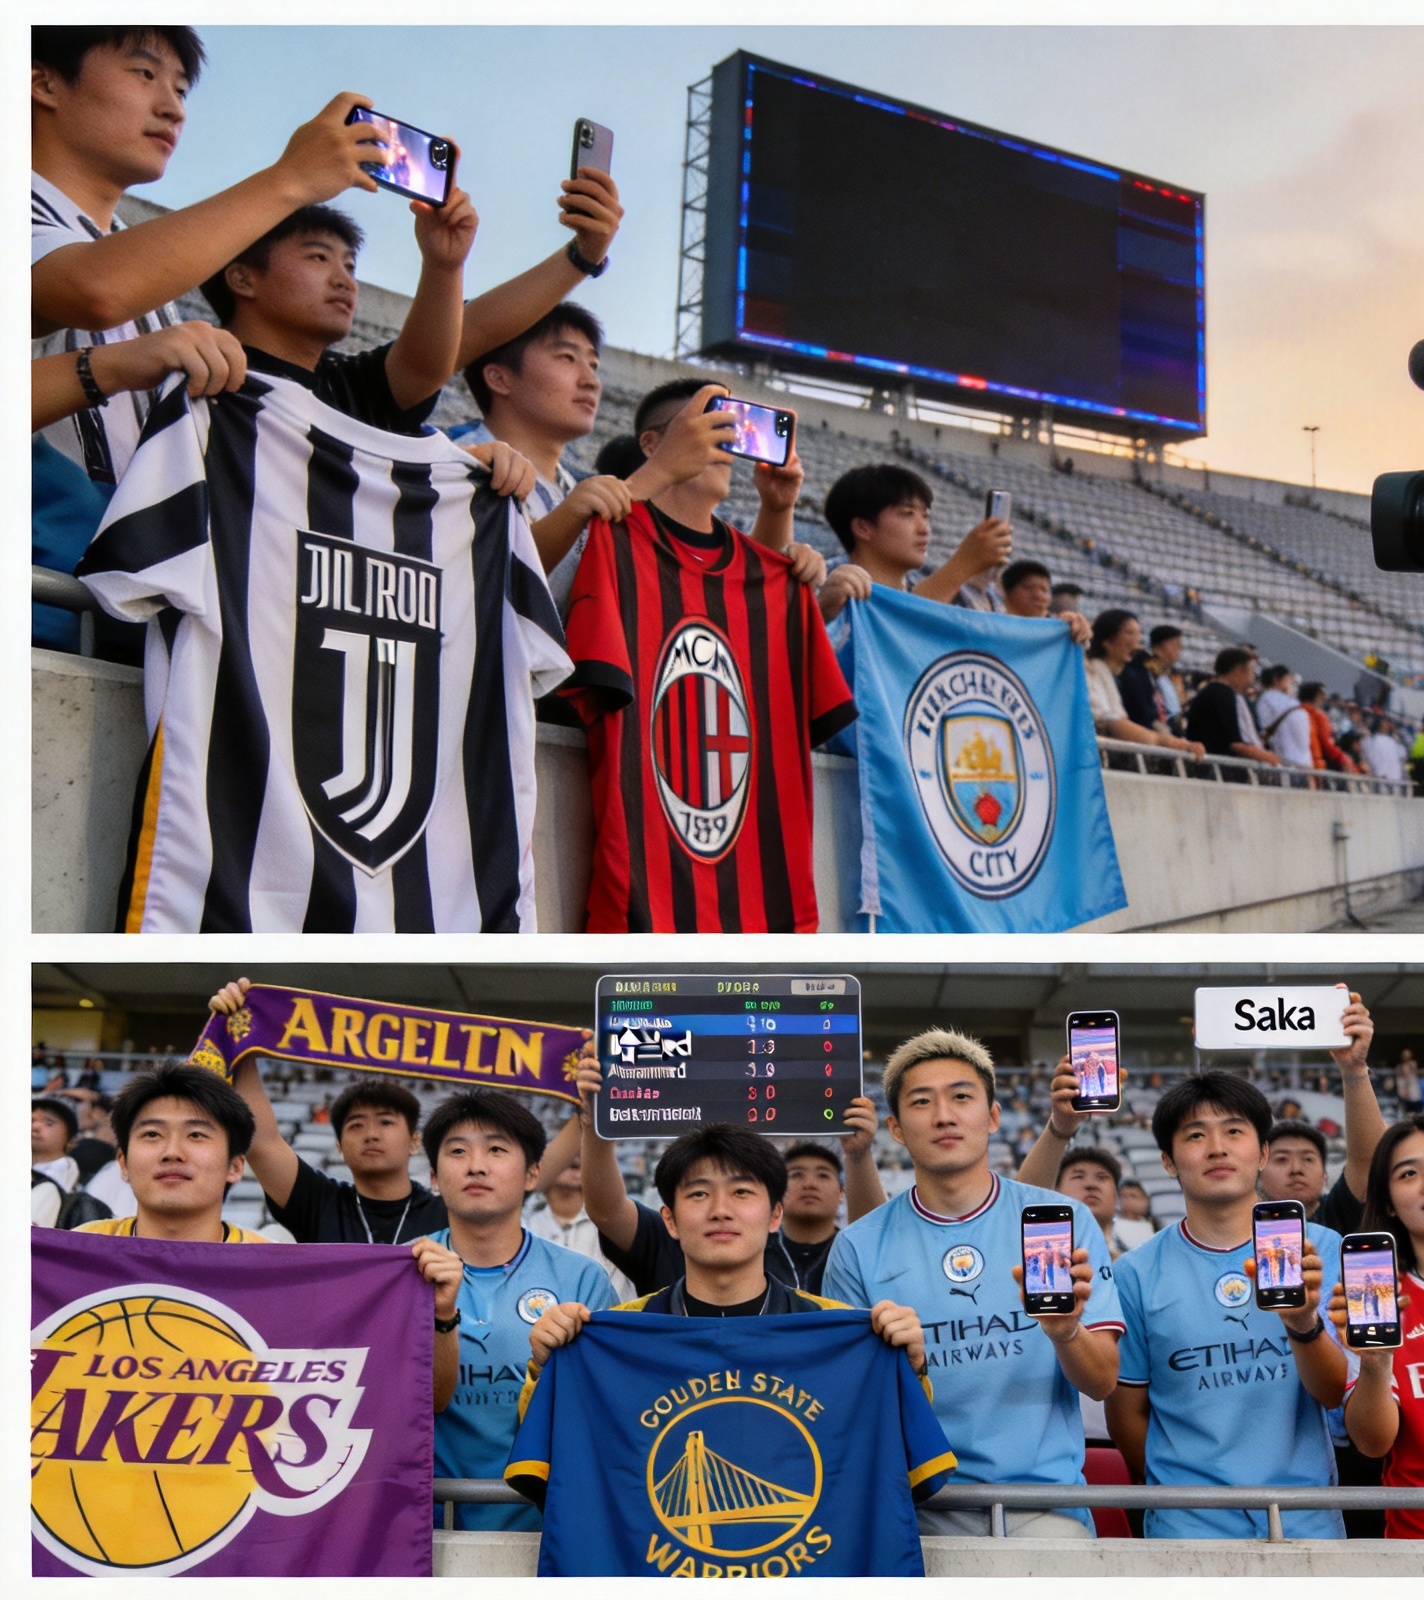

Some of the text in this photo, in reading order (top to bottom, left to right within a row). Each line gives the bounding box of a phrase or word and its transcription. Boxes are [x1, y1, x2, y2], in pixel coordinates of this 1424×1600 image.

[969, 849, 1019, 877] CITY
[1234, 997, 1316, 1031] Saka
[926, 1339, 1024, 1367] AIRWAYS
[83, 1354, 348, 1383] LOS ANGELES
[751, 1372, 825, 1421] STATE
